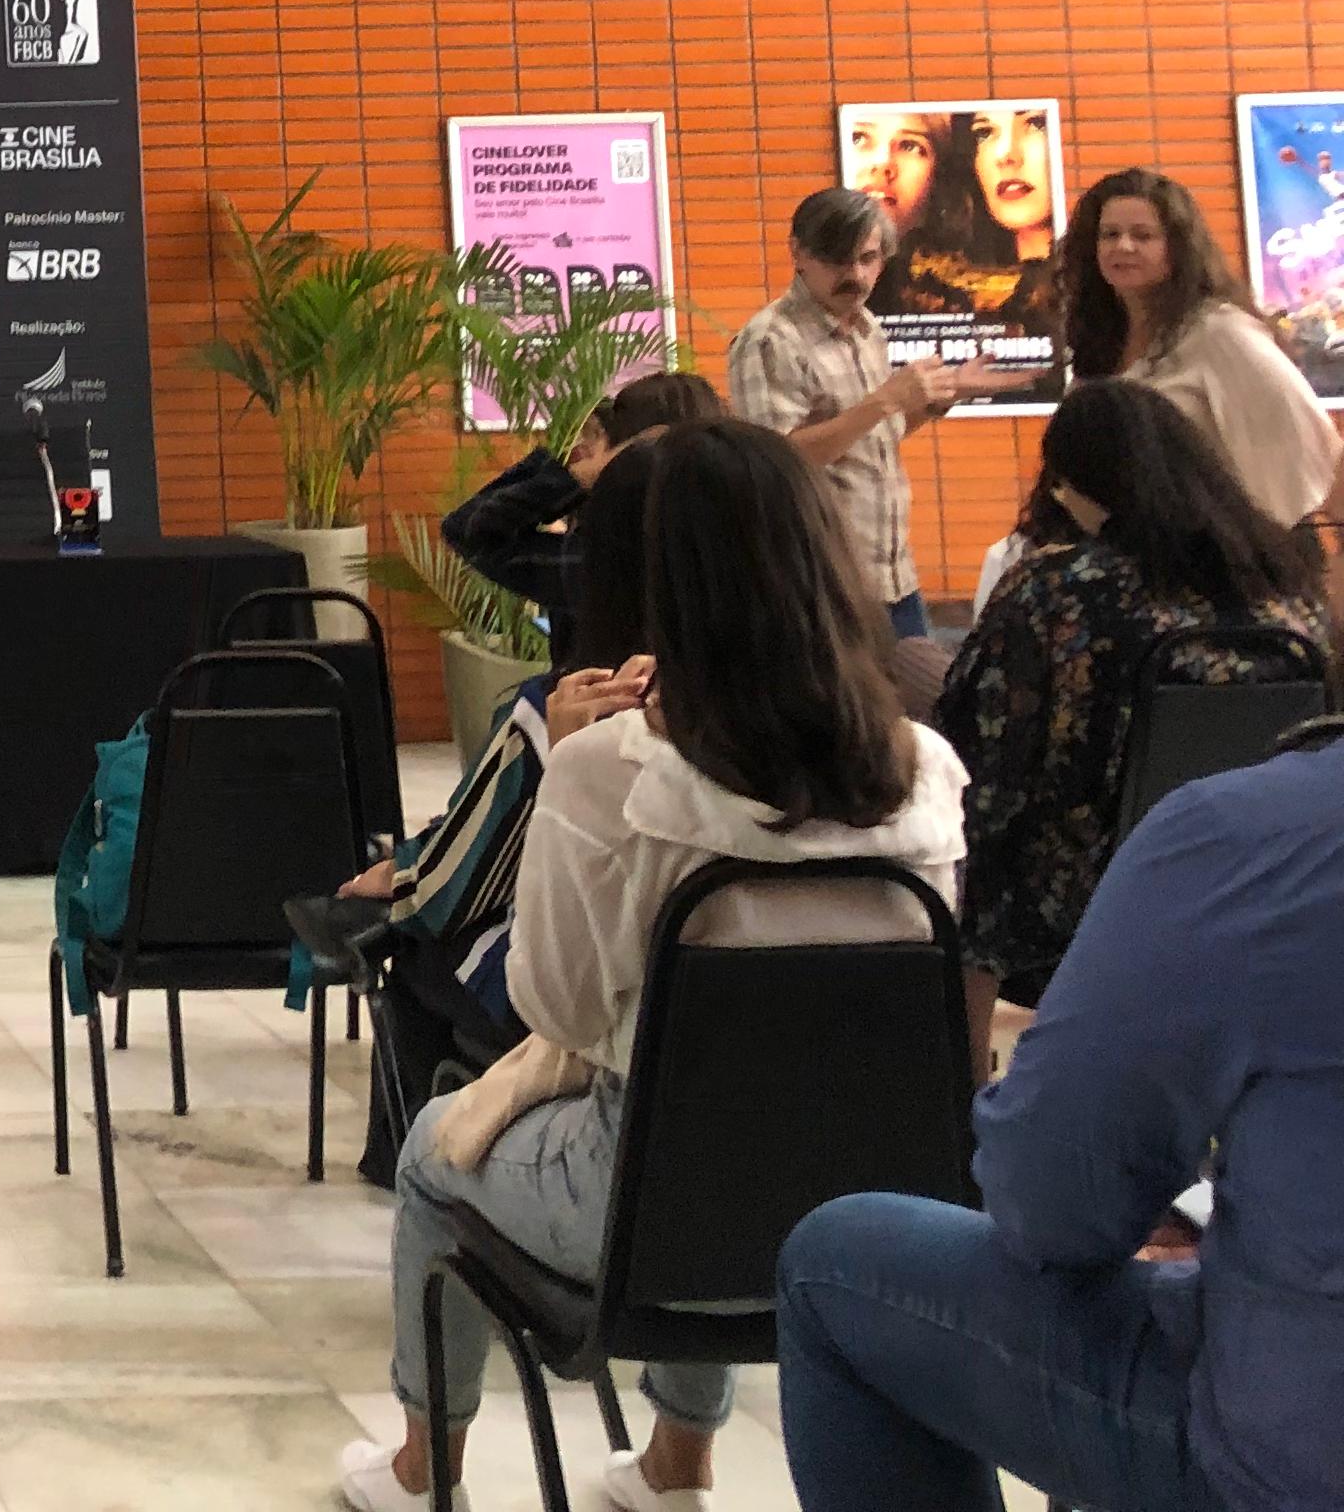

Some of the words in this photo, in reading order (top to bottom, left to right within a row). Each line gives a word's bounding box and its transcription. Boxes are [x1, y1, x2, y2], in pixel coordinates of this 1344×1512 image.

[14, 24, 52, 40] anos
[14, 40, 53, 61] FBCB
[22, 125, 77, 148] CINE
[0, 144, 103, 171] BRASÍLIA
[472, 144, 569, 159] CINELOVER
[473, 162, 573, 176] PROGRAMA
[474, 181, 497, 194] DE
[500, 177, 598, 193] FIDELIDADE
[40, 248, 101, 281] BRB
